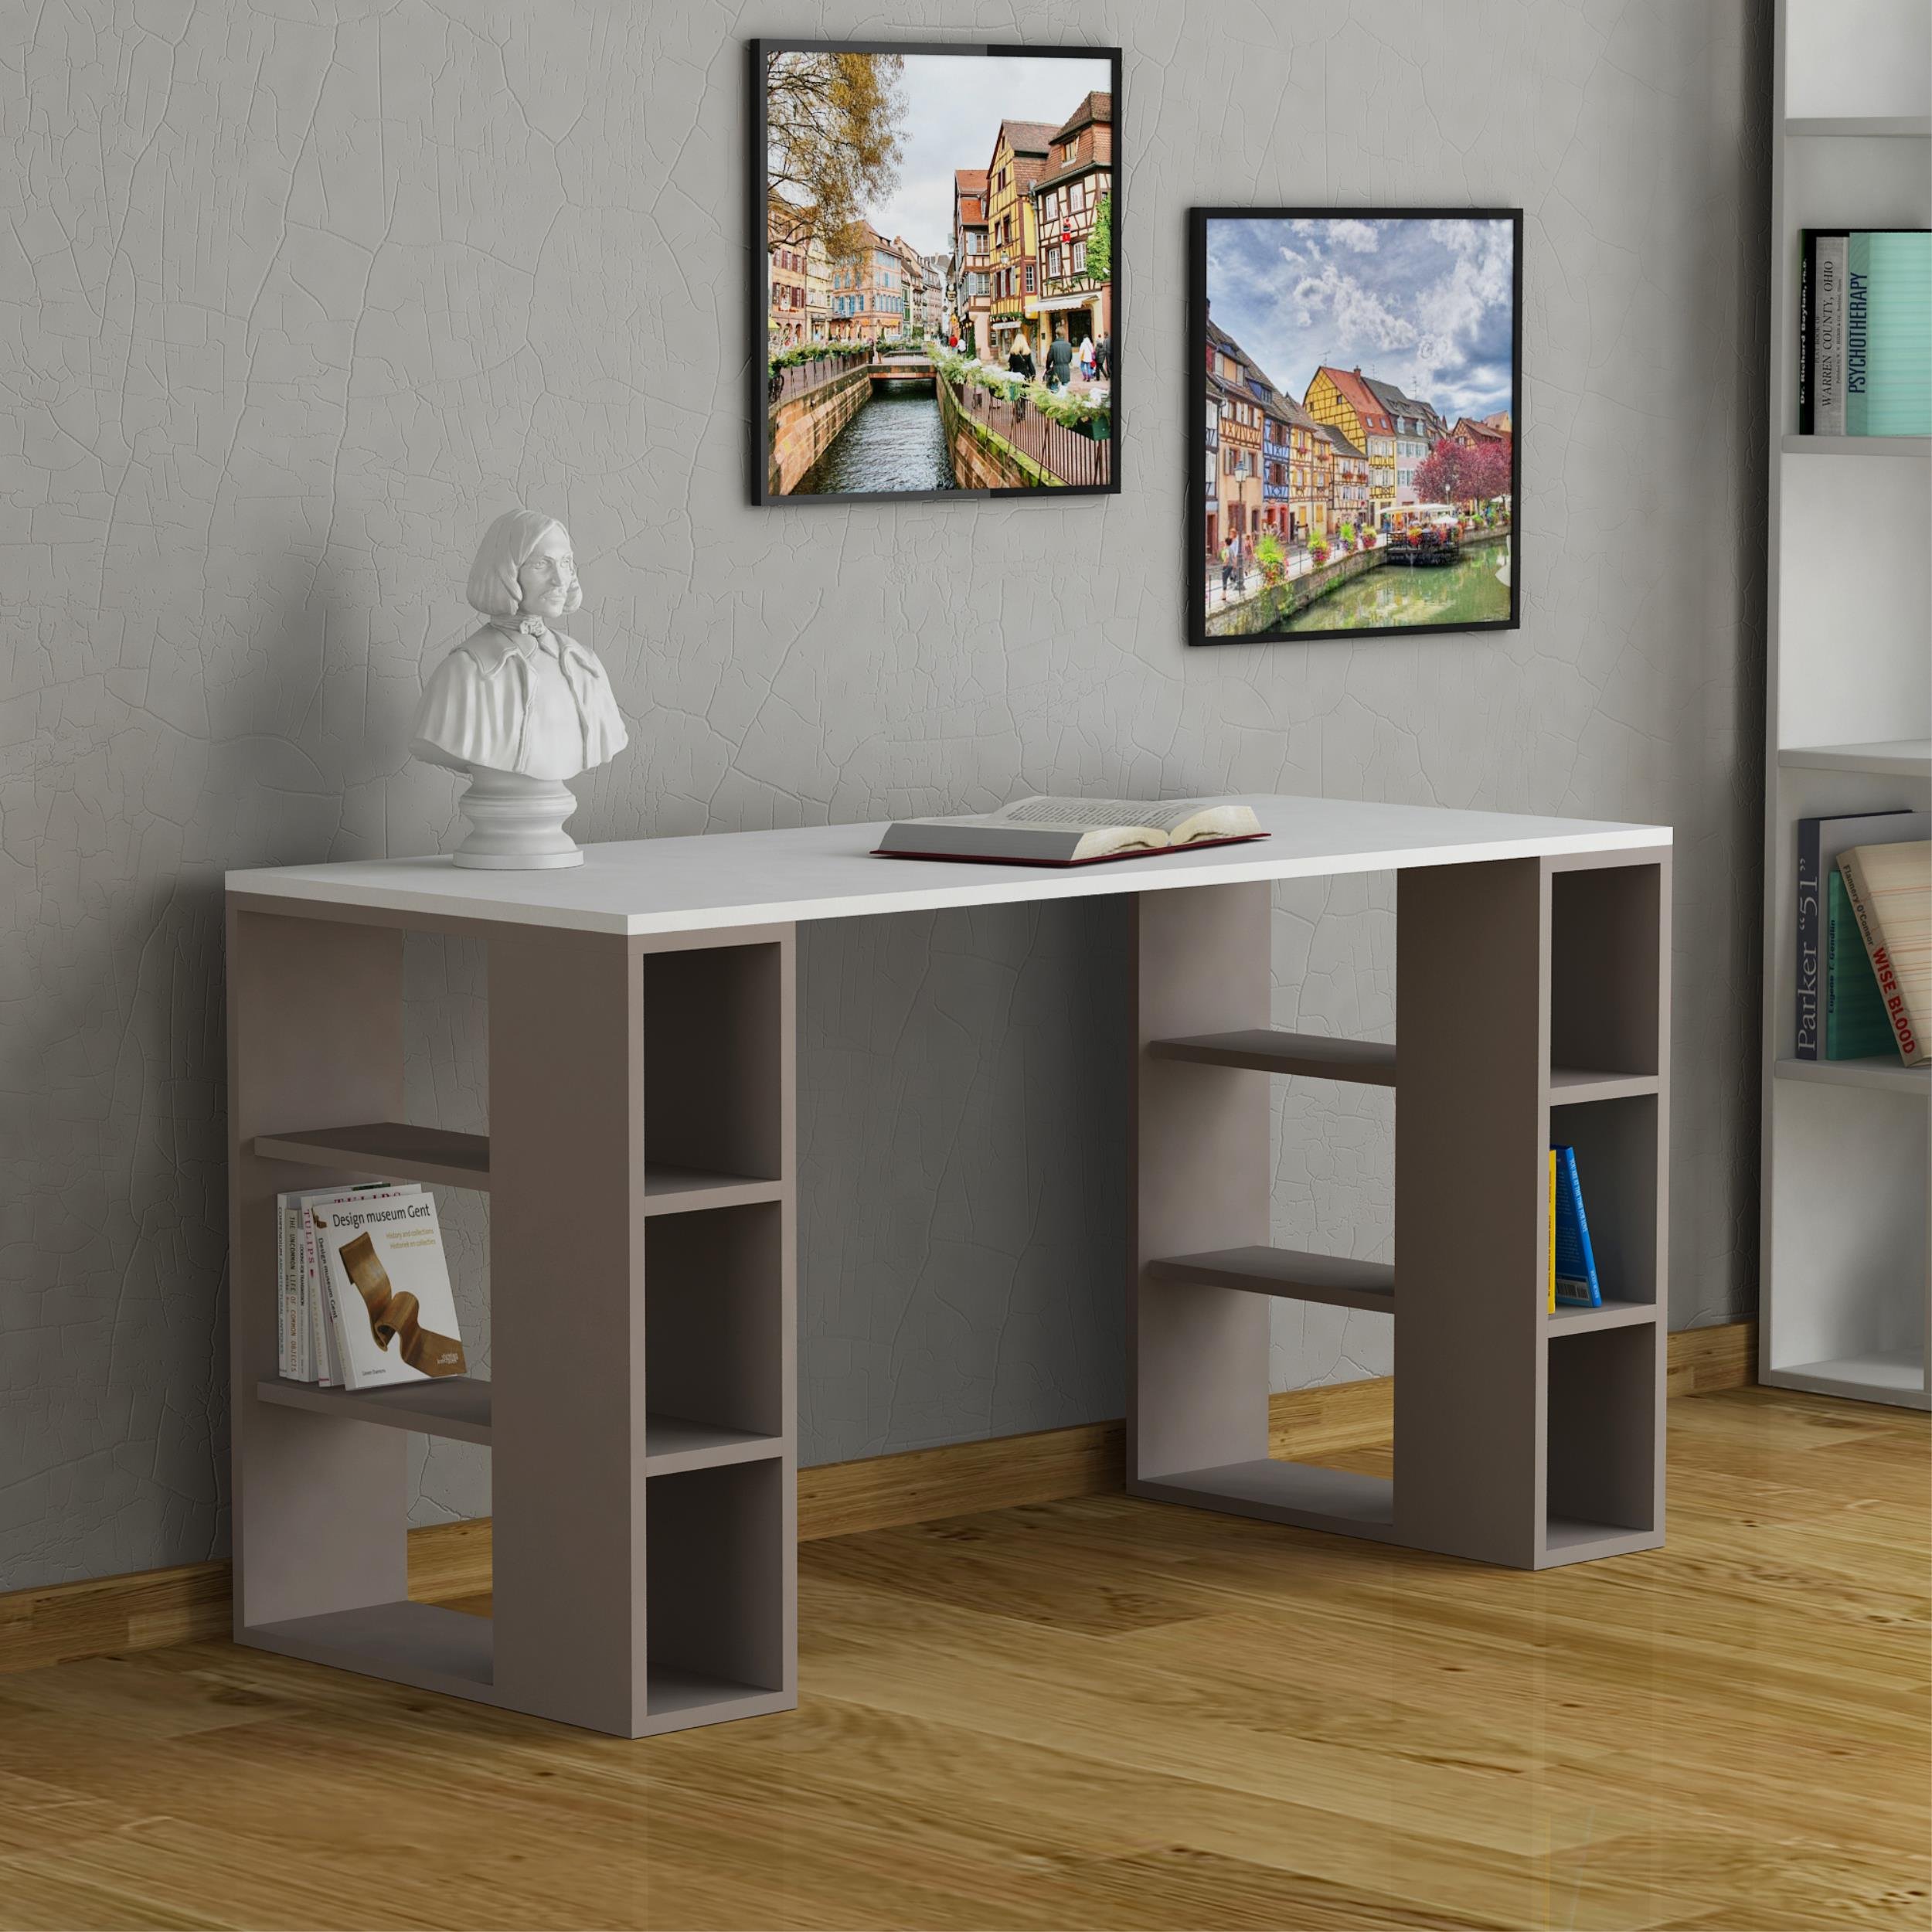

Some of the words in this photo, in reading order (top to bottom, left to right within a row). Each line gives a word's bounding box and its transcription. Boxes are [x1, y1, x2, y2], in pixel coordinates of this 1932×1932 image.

[1824, 260, 1833, 291] OHIO
[1823, 297, 1834, 349] COUNTY,
[1849, 272, 1867, 393] PSYCHOTHERAPY
[1822, 355, 1832, 406] WARREN
[1843, 864, 1861, 903] Flannery
[1856, 904, 1874, 946] O'Connor
[1798, 941, 1817, 1051] Parker
[1873, 947, 1897, 995] WISE
[1888, 995, 1916, 1054] BLOOD
[304, 1209, 315, 1264] TULIPS
[332, 1212, 365, 1229] Design
[366, 1207, 406, 1223] museum
[406, 1203, 431, 1219] Gent
[291, 1295, 297, 1305] OF
[318, 1237, 327, 1264] Design
[324, 1265, 334, 1298] museum
[329, 1299, 338, 1318] Gent
